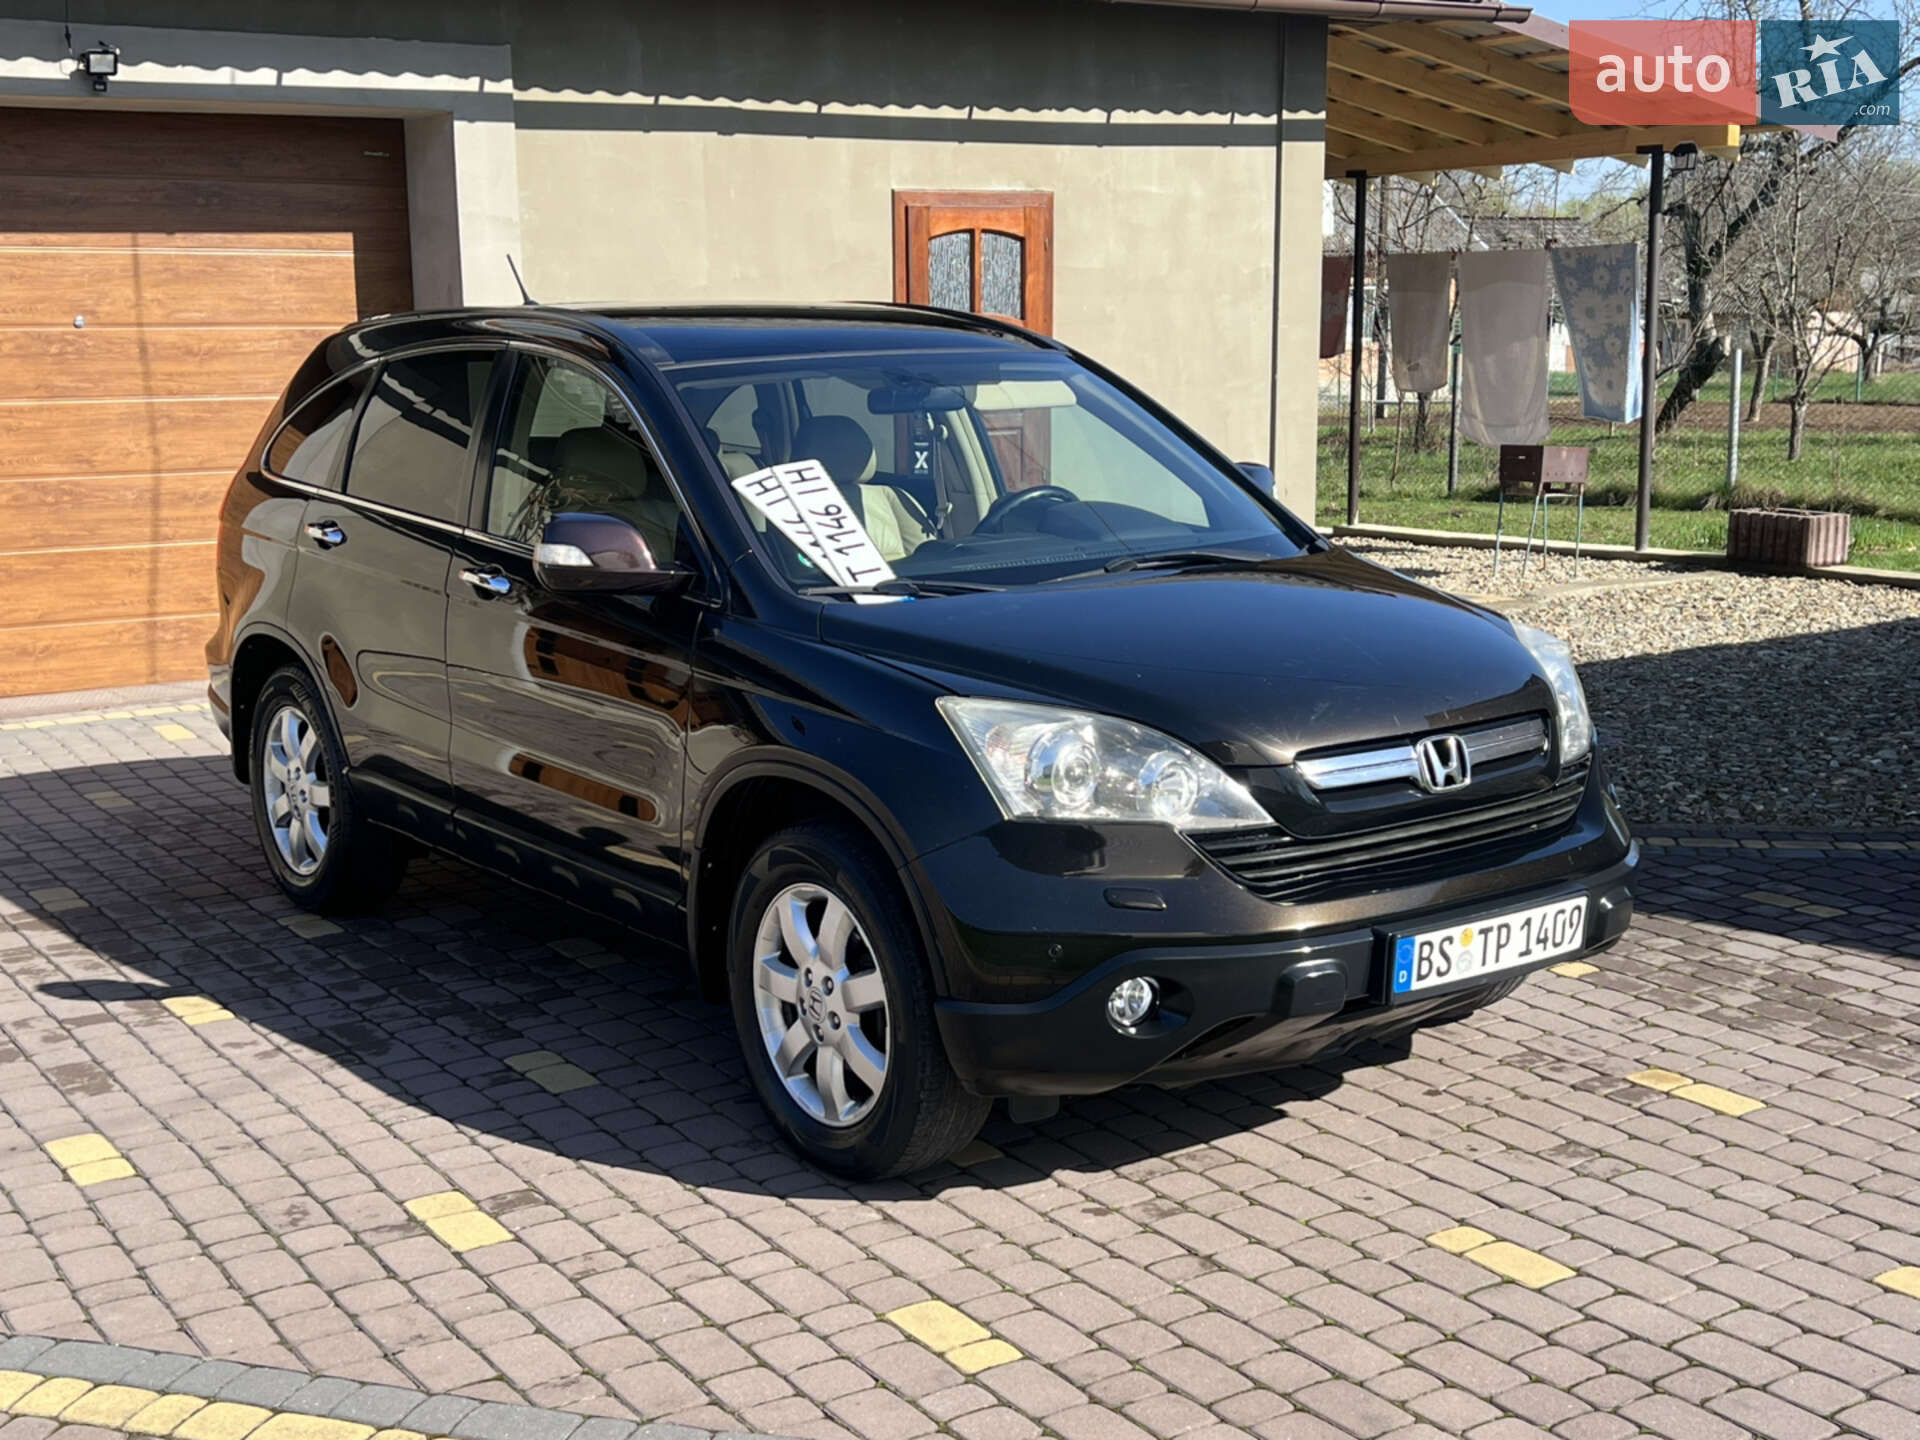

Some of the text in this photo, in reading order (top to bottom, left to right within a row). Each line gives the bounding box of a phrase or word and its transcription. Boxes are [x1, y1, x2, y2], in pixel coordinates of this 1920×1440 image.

[1416, 905, 1582, 982] BS TP 1409
[1399, 970, 1407, 983] D
